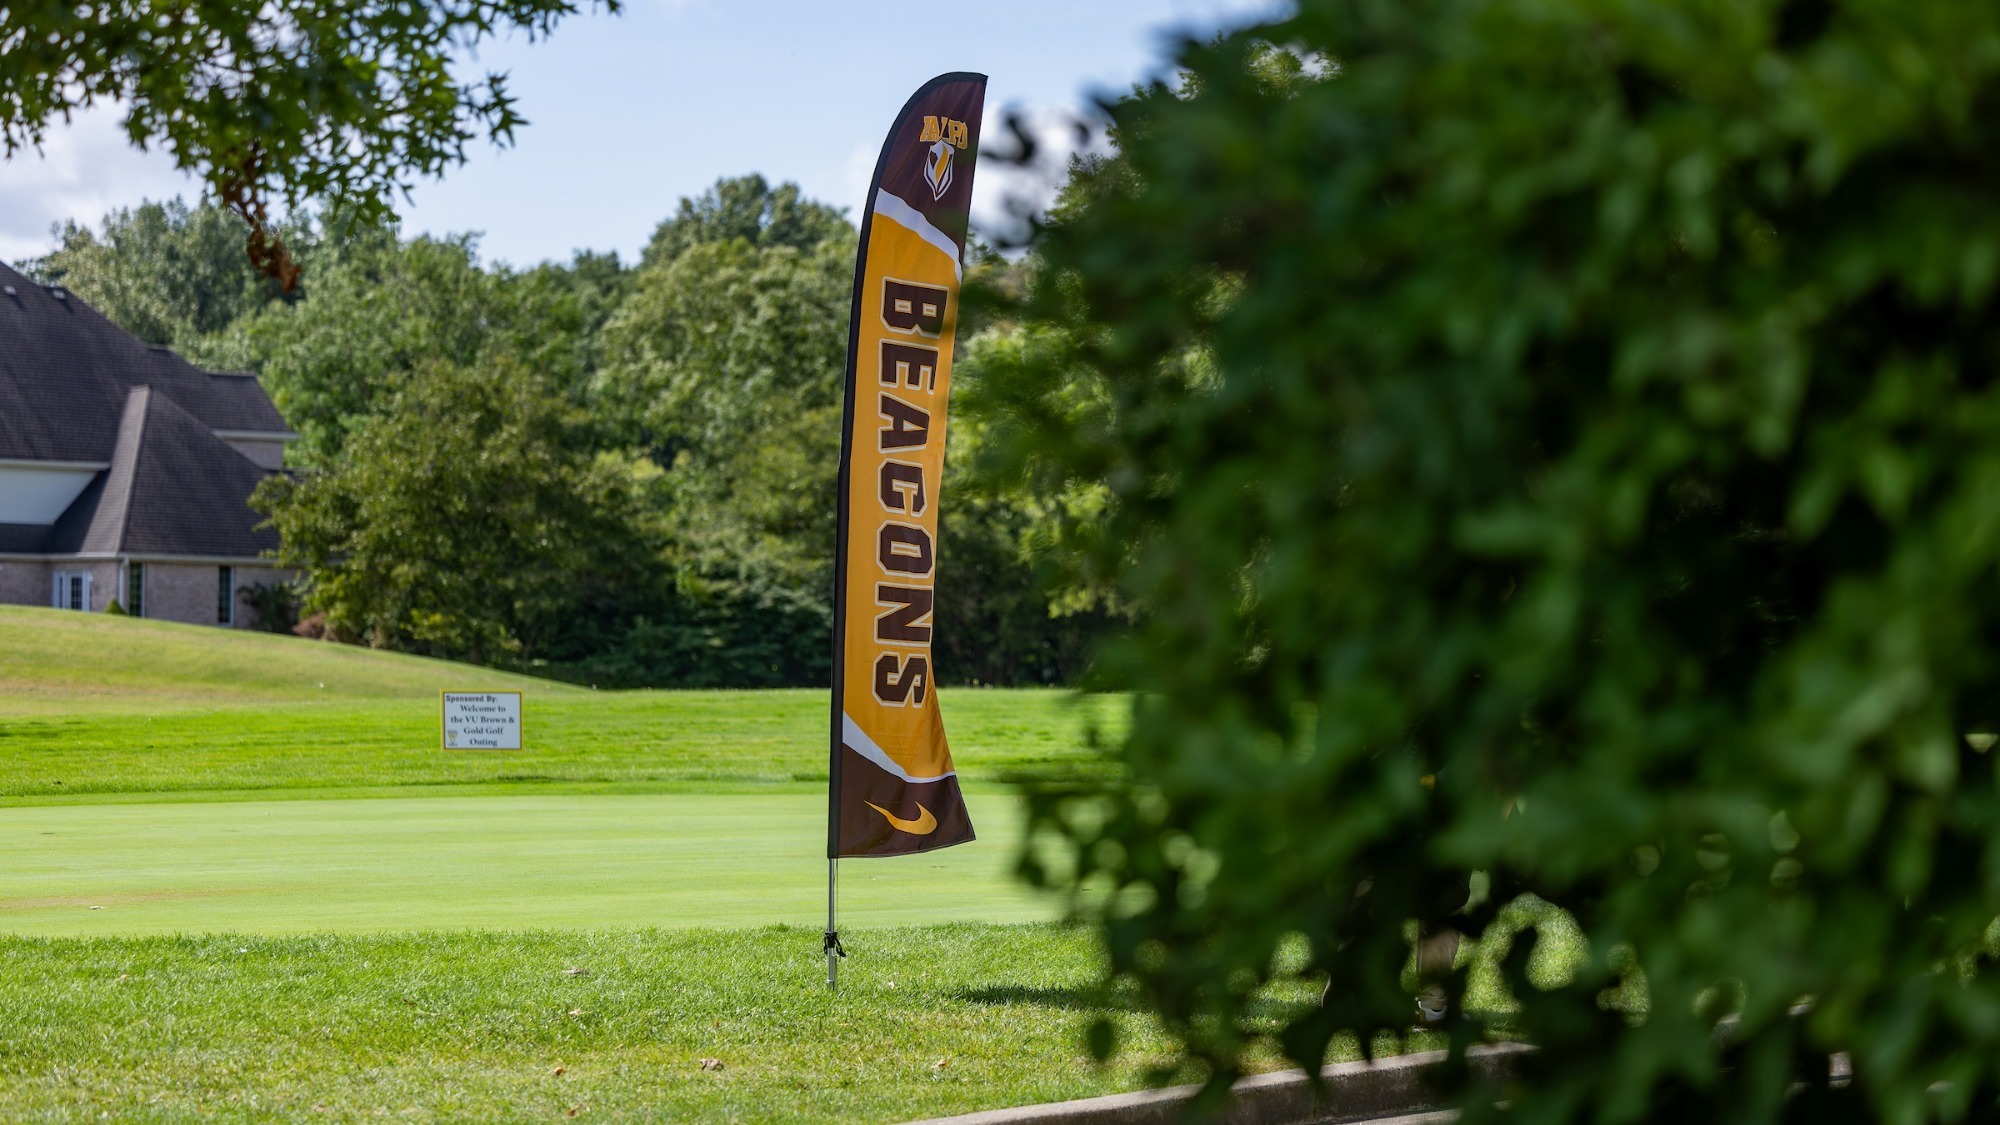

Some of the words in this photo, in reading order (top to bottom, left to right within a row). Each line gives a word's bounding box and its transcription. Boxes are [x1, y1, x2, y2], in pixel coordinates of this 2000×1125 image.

[872, 275, 949, 709] BEACONS
[446, 695, 484, 703] Sponsored
[460, 705, 497, 713] Welcome
[498, 705, 506, 713] to
[450, 715, 464, 724] the
[465, 715, 479, 724] VU
[480, 715, 507, 724] Brown
[508, 716, 516, 724] &
[463, 726, 484, 735] Gold
[485, 726, 504, 735] Golf
[469, 738, 498, 747] Outing
